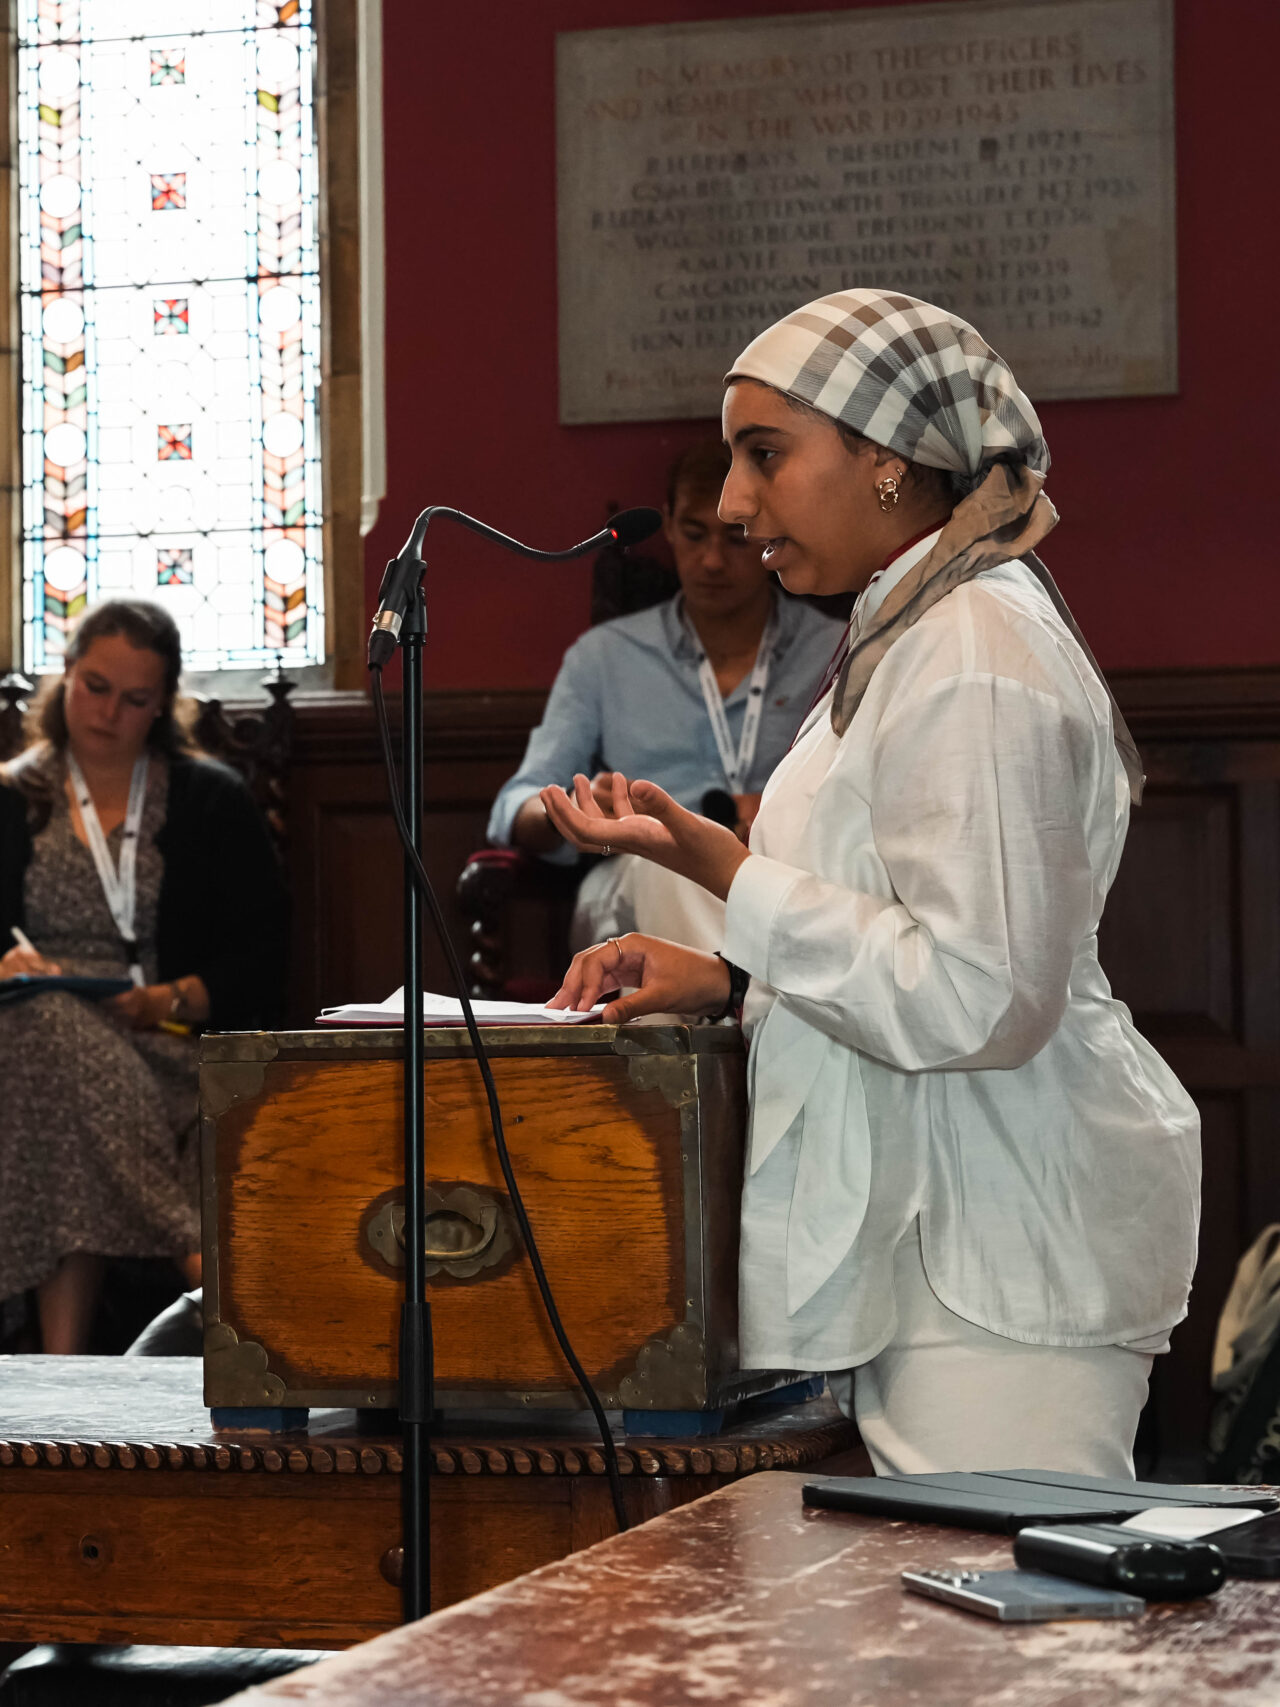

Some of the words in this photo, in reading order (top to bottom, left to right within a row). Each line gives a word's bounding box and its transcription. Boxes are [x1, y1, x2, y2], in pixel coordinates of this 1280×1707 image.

[636, 66, 666, 88] IN
[680, 55, 801, 85] MEMORY
[820, 50, 856, 76] OF
[873, 45, 928, 71] THE
[941, 33, 1083, 66] OFFICERS
[794, 80, 868, 106] WHO
[882, 75, 953, 102] LOST
[970, 66, 1056, 95] THEIR
[1070, 58, 1148, 88] LIVES
[697, 122, 728, 142] IN
[747, 117, 793, 142] THE
[810, 110, 873, 135] WAR
